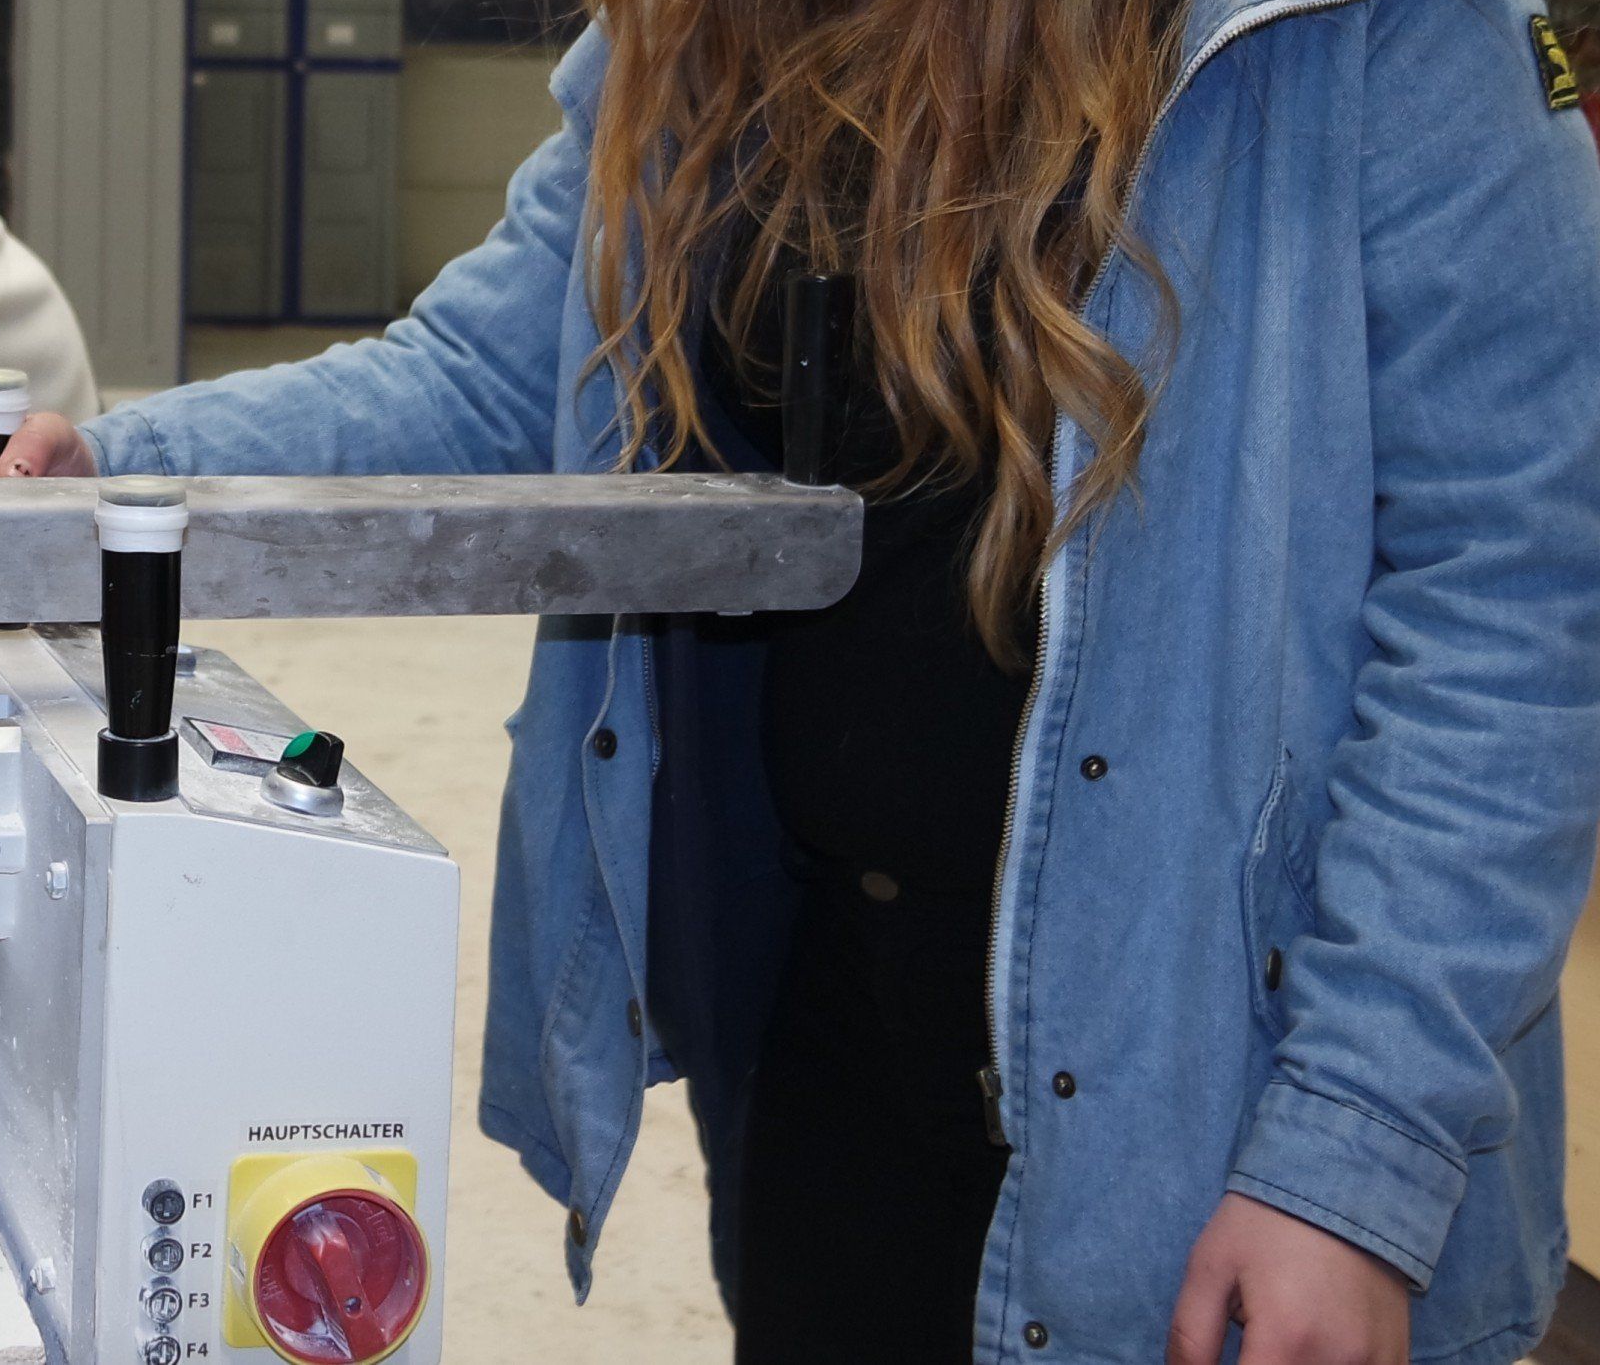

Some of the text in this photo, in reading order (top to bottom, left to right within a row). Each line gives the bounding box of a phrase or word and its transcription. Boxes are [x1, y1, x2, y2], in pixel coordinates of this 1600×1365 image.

[248, 1123, 404, 1142] HAUPTSCHALTER
[192, 1193, 213, 1208] F1
[190, 1243, 212, 1258] F2
[188, 1293, 210, 1308] F3
[186, 1343, 208, 1357] F4
